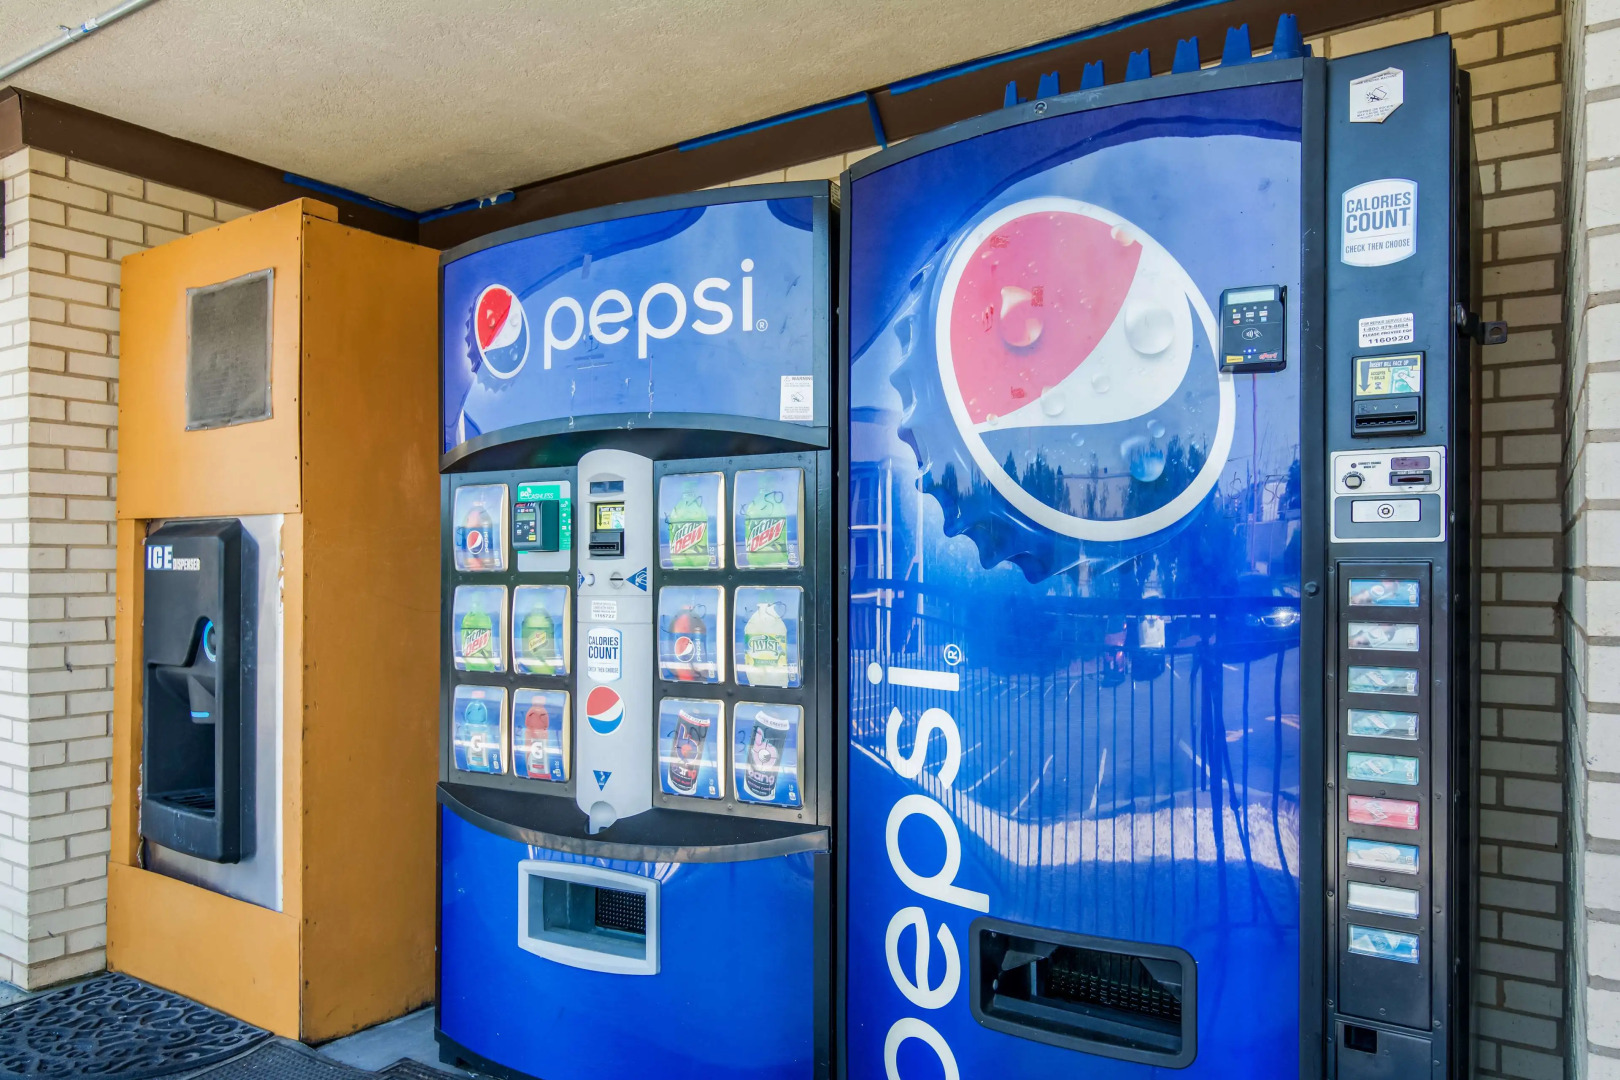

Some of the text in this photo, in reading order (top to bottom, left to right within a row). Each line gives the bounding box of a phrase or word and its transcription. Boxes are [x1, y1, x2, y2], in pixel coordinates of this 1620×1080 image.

[1346, 191, 1411, 213] CALORIES
[1346, 206, 1410, 234] COUNT
[1345, 238, 1411, 254] CHECK THEN CHOOSE
[543, 258, 754, 370] pepsi
[147, 545, 200, 571] ICE DISPENSER
[588, 635, 619, 647] CALORIES
[749, 639, 780, 656] TWIST
[588, 646, 619, 660] COUNT
